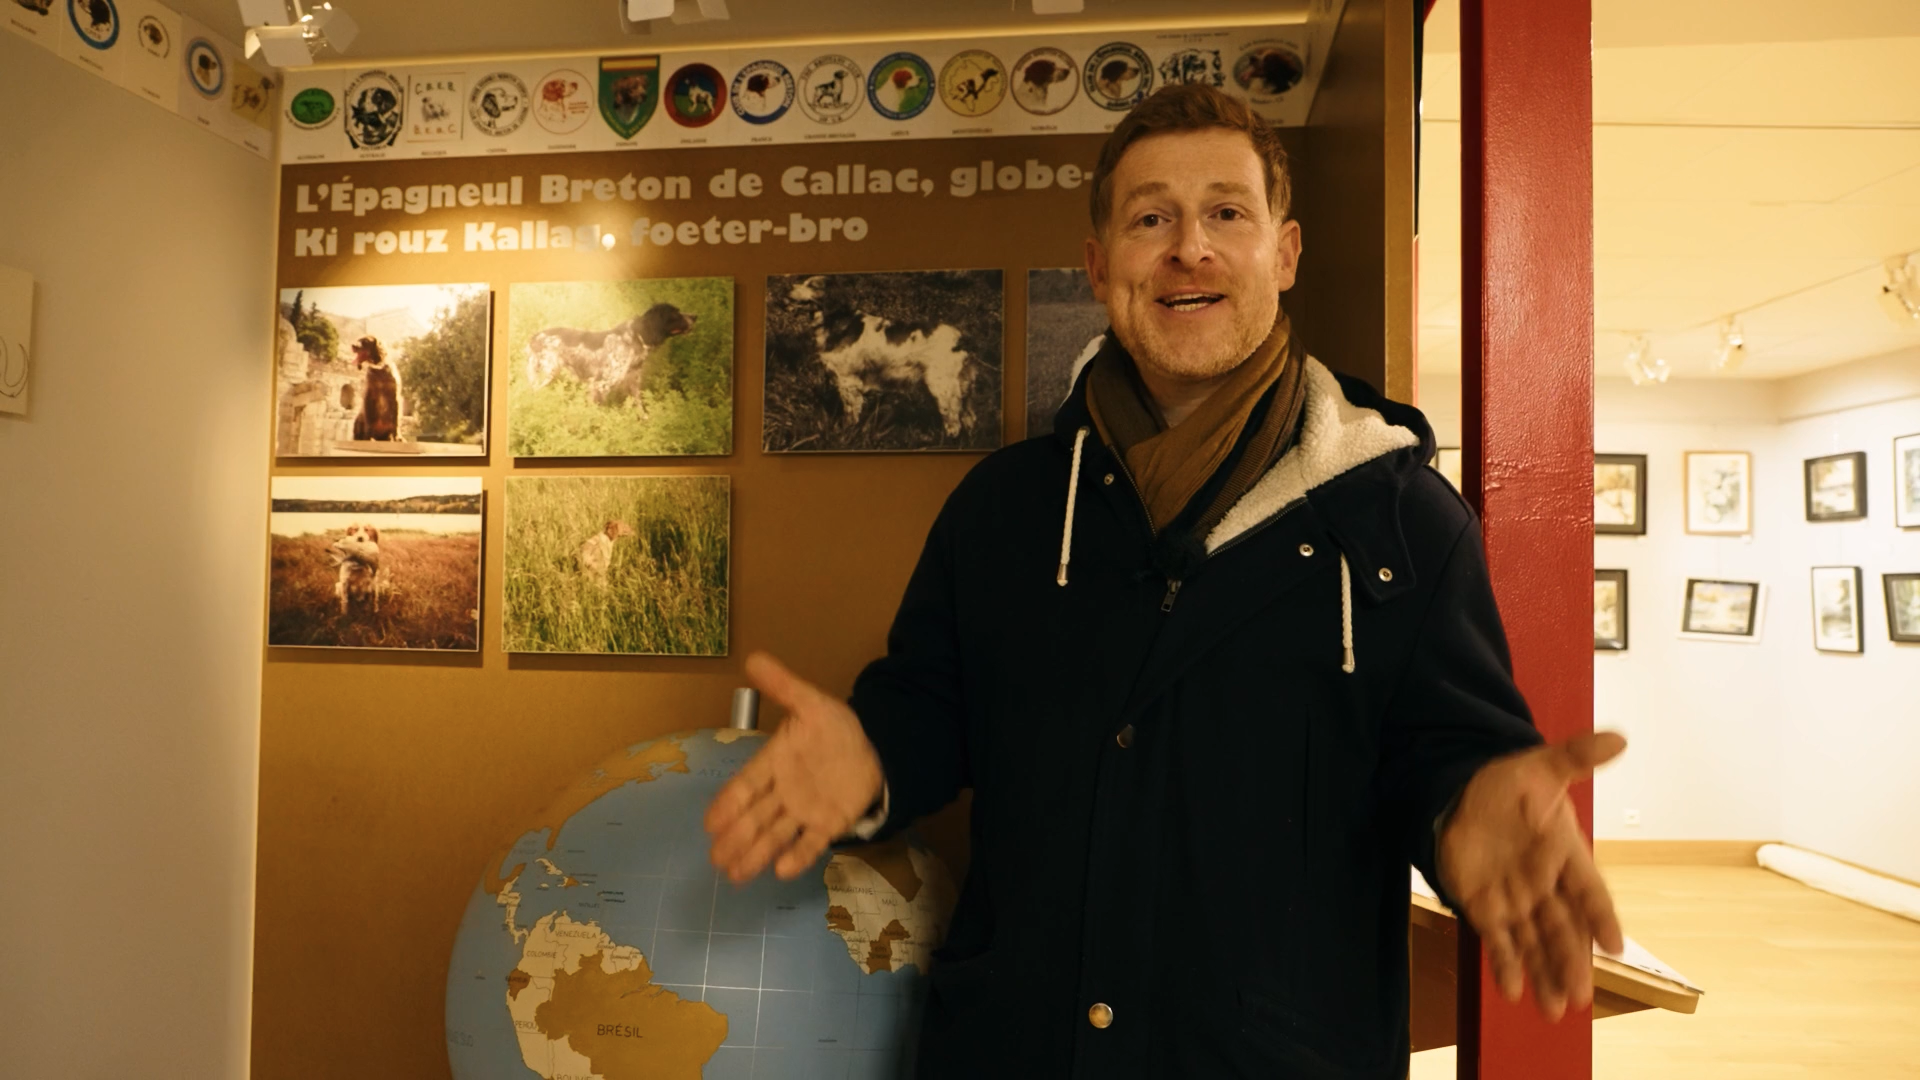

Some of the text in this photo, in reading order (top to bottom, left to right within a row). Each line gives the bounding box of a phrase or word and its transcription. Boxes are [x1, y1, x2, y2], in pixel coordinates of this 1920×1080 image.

[296, 175, 523, 216] L'Épagneul
[540, 172, 691, 204] Breton
[708, 168, 763, 198] de
[781, 164, 934, 197] Callac,
[295, 228, 337, 257] Ki
[353, 228, 448, 255] rouz
[630, 213, 868, 246] foeter-bro
[555, 929, 597, 940] VENEZUELA
[525, 950, 558, 959] COLOMBIE
[597, 1022, 644, 1039] BRÉSIL
